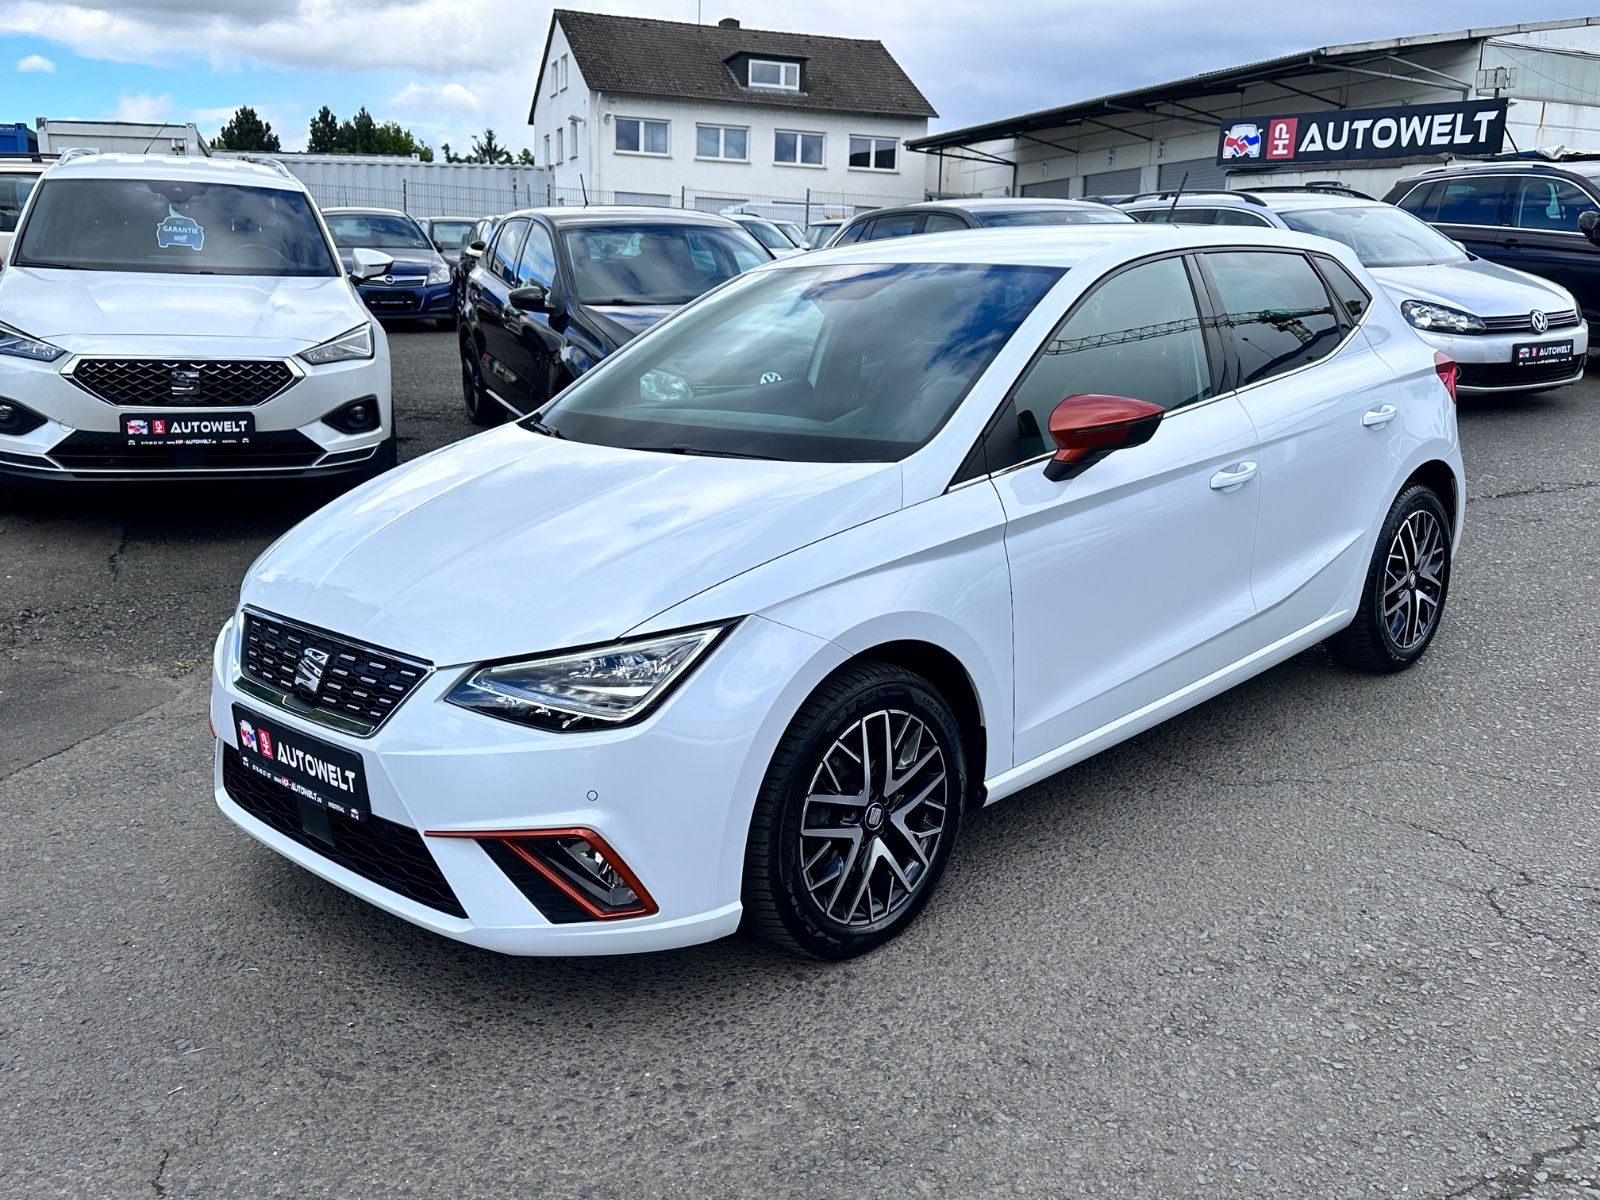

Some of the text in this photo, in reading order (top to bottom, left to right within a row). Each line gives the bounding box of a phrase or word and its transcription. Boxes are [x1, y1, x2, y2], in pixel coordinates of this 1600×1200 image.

[1272, 110, 1499, 155] HP AUTOWELT
[162, 225, 198, 235] GARANTIE
[1539, 345, 1571, 356] AUTOWELT
[170, 420, 248, 434] AUTOWELT
[277, 741, 356, 793] AUTOWELT
